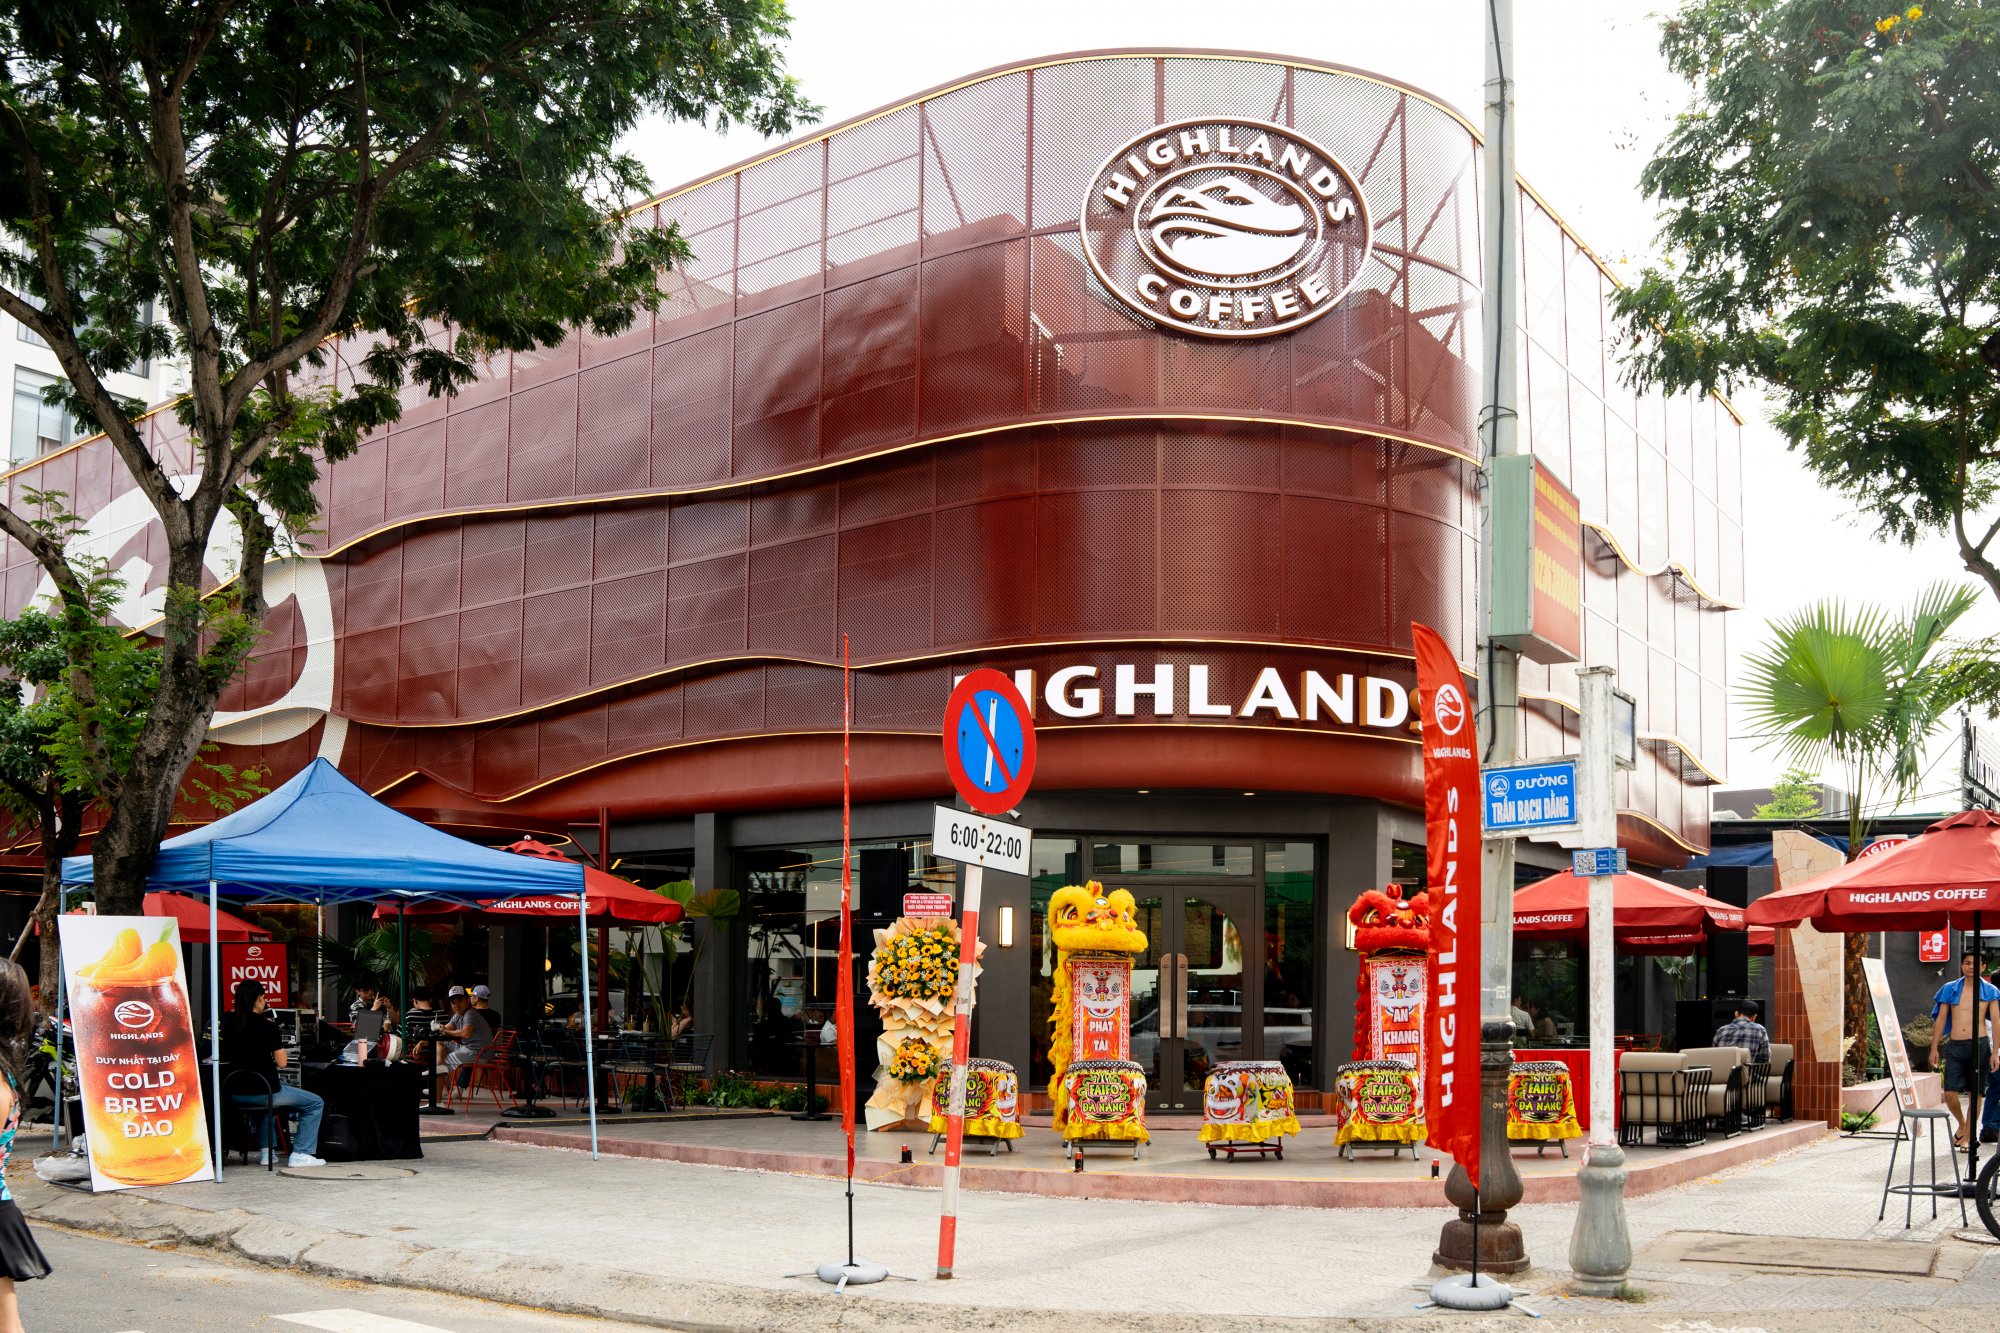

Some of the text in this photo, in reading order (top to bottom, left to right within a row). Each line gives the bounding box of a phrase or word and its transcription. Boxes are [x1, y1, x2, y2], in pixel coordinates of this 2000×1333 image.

[1103, 128, 1355, 224] HIGHLANDS
[1137, 273, 1331, 323] COFFEE
[954, 664, 1422, 731] IGHLAND
[1432, 747, 1471, 759] HIGHLANDS
[1515, 773, 1568, 790] ĐƯỜNG
[1491, 795, 1516, 824] TRẦN
[1517, 798, 1542, 824] BẠCH
[1849, 888, 1988, 904] HIGHLANDS COFFEE
[1542, 914, 1573, 923] COFFEE
[1438, 786, 1460, 1107] HIGHLANDS
[231, 965, 279, 980] NOW
[1393, 1008, 1408, 1023] AN
[1089, 1019, 1114, 1032] PHÁT
[110, 1032, 164, 1040] HIGHLANDS
[1383, 1031, 1419, 1045] KHANG
[96, 1054, 180, 1065] DUY NHẤT TẠI ĐÂY
[107, 1071, 176, 1090] COLD
[1089, 1084, 1120, 1095] FAIFO
[1372, 1084, 1402, 1096] FAIFO
[1528, 1083, 1556, 1094] FAIFO
[104, 1093, 183, 1114] BREW
[123, 1116, 174, 1138] ĐÀO
